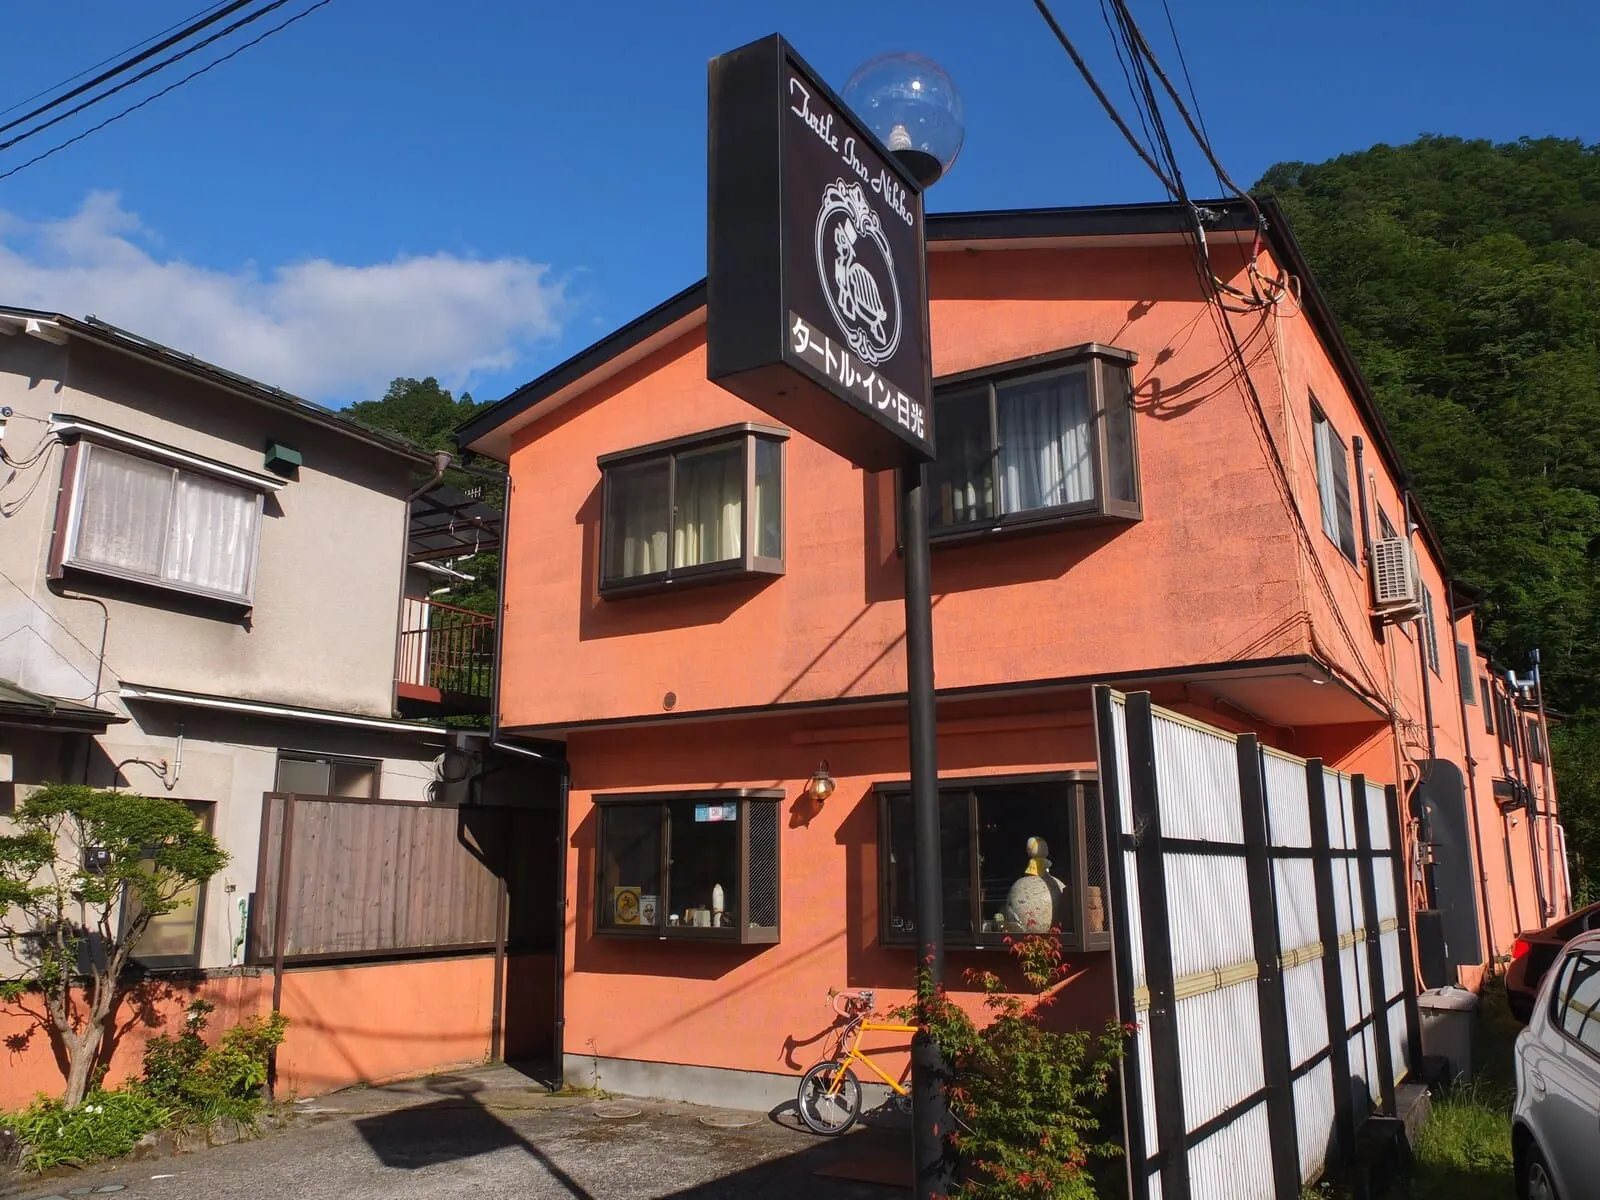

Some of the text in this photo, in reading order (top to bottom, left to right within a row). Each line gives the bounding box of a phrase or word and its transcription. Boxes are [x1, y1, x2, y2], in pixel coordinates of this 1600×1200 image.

[789, 77, 914, 226] Turtle Inn Nikko
[792, 317, 924, 439] タートル・イン・日光
